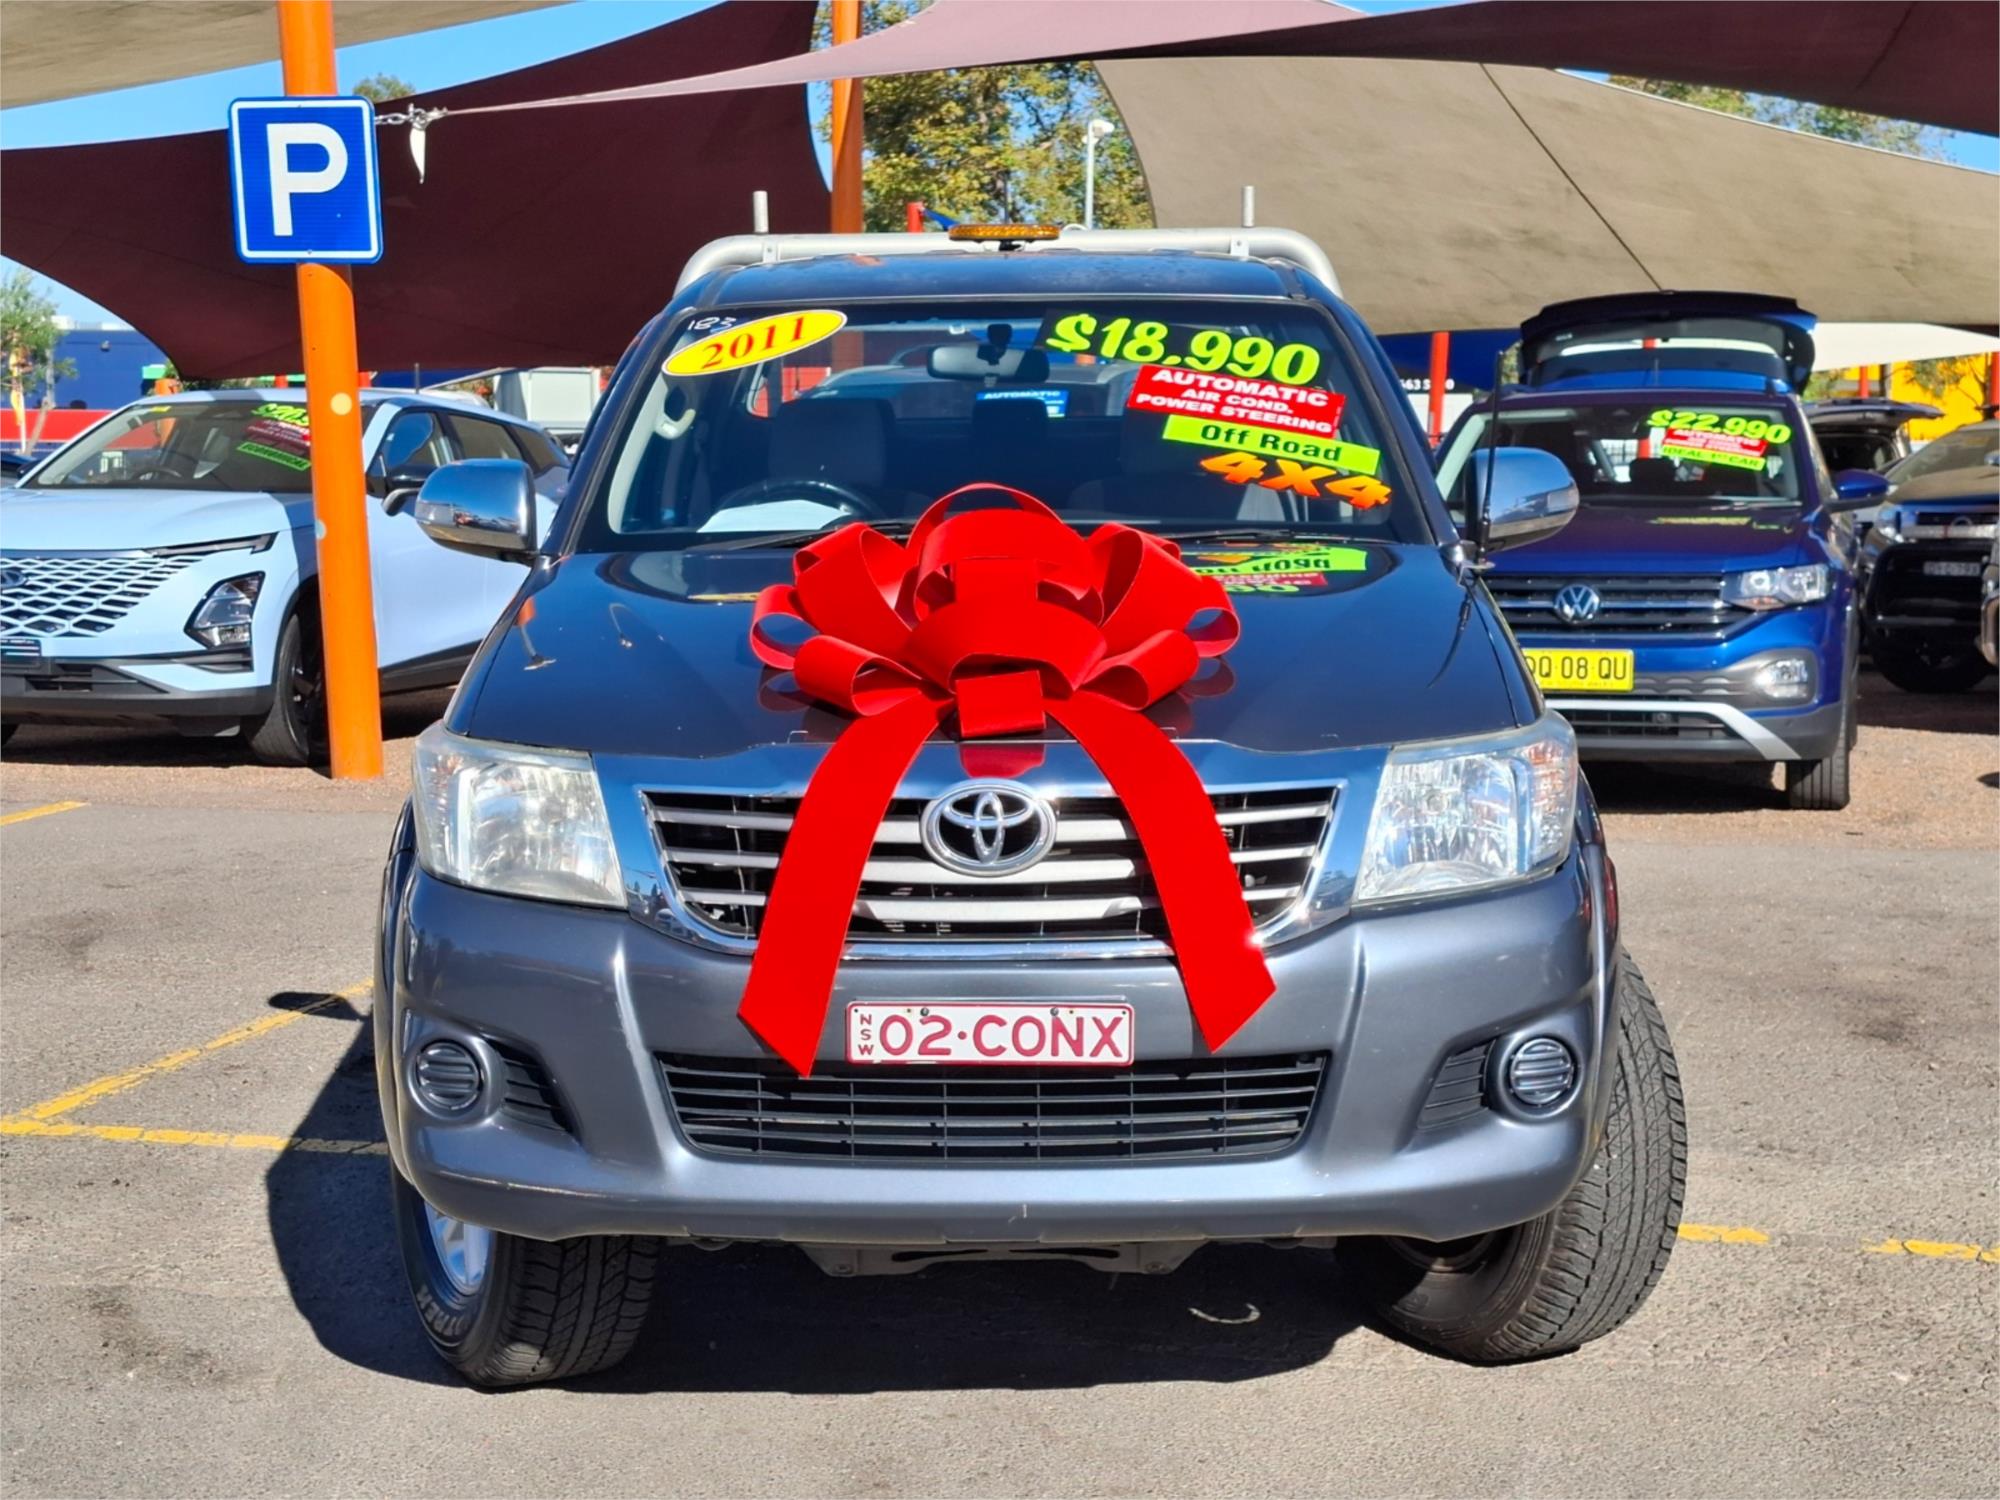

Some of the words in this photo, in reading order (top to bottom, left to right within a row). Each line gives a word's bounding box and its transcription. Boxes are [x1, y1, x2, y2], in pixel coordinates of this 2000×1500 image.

[266, 122, 348, 236] P
[701, 317, 804, 369] 2011
[1151, 370, 1329, 407] AUTOMATIC
[1181, 389, 1221, 402] AIR
[1224, 394, 1294, 414] COND.
[1136, 394, 1216, 413] POWER
[1220, 405, 1333, 434] STEERING
[1200, 424, 1251, 445] Off
[1259, 433, 1343, 462] Road
